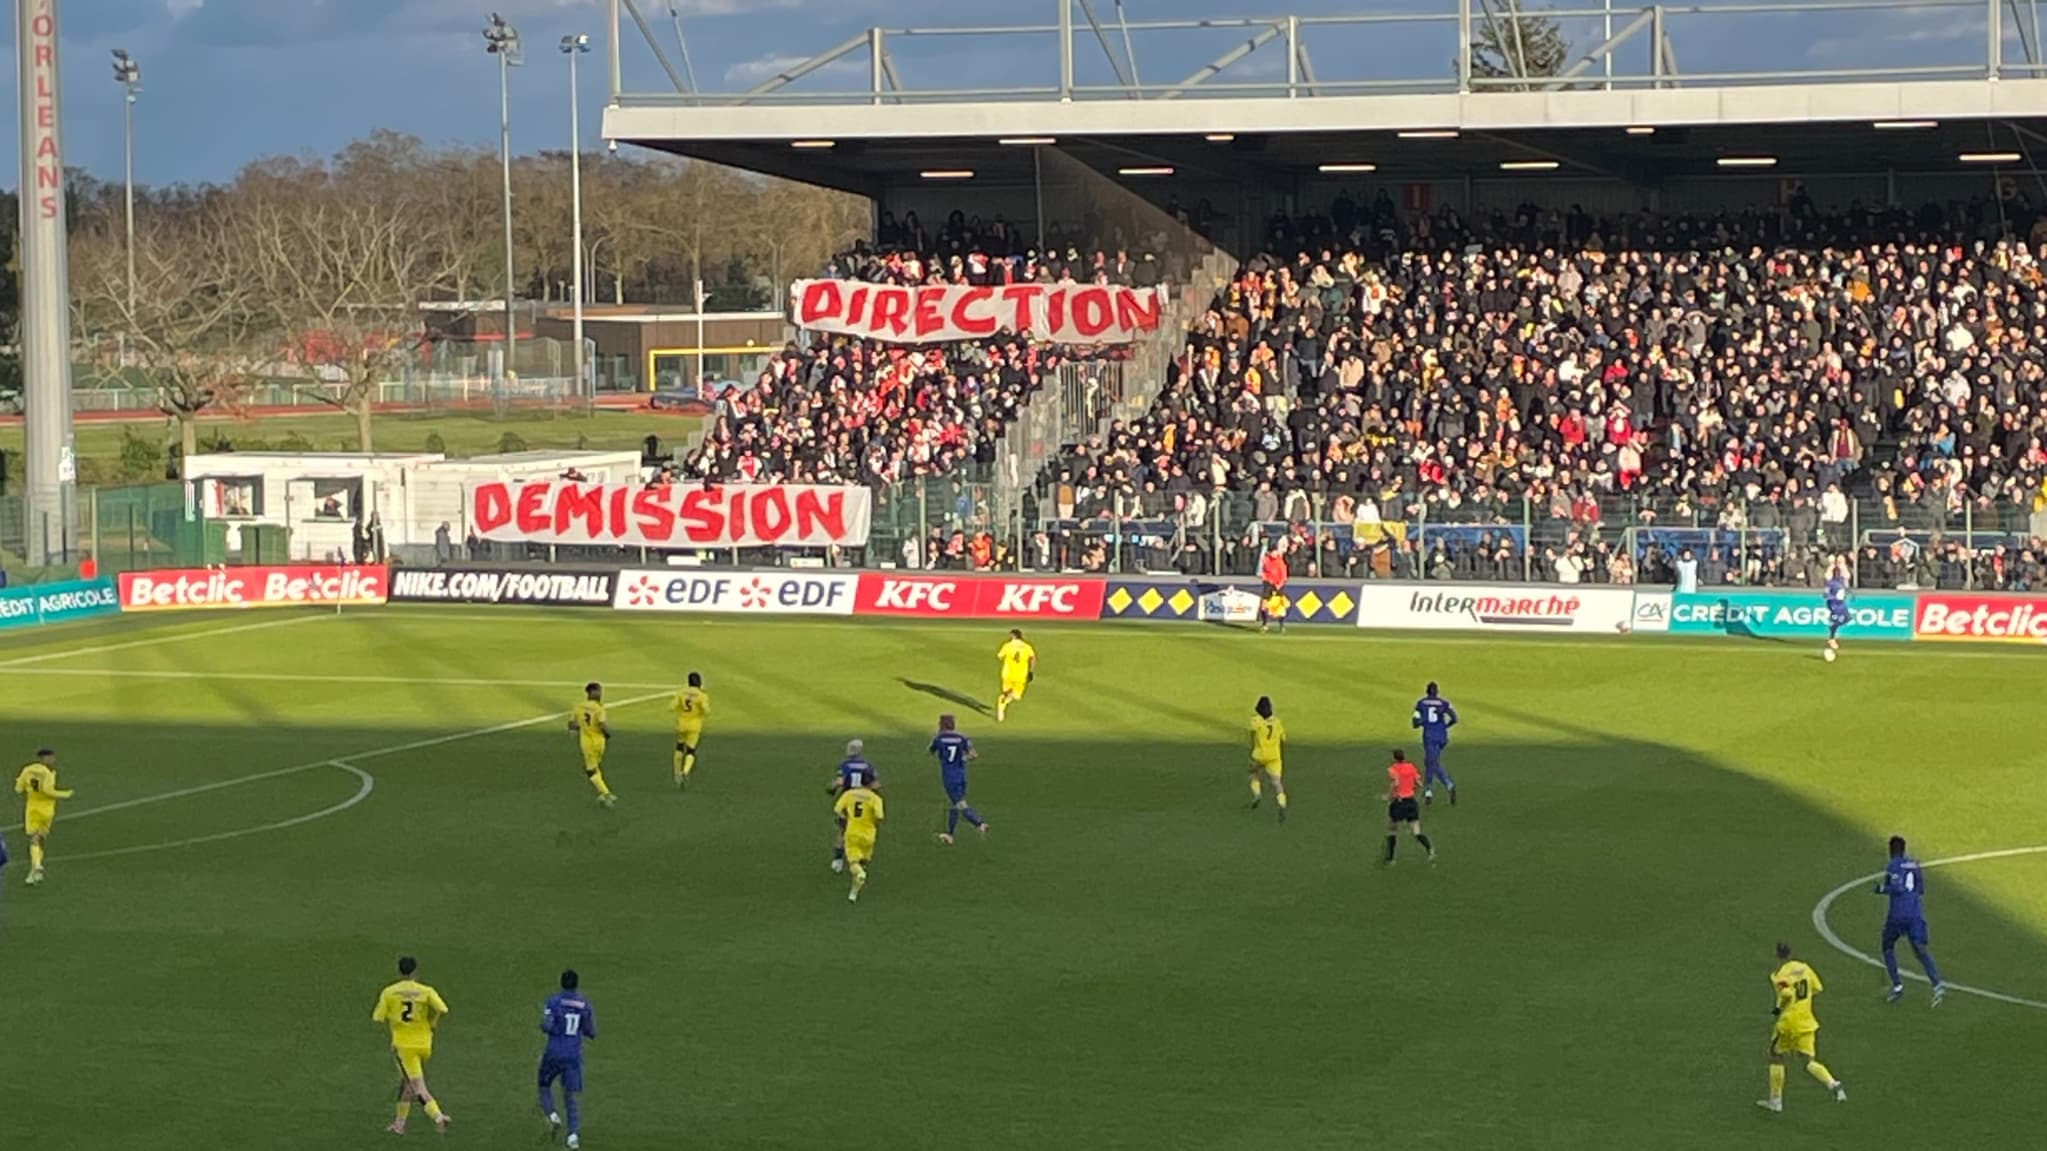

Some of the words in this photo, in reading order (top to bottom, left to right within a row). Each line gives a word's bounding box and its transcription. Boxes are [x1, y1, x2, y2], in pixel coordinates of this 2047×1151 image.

[801, 278, 1162, 337] DIRECTION
[474, 481, 846, 542] DEMISSION
[130, 572, 245, 606] Betclic
[263, 569, 379, 601] Betclic
[393, 570, 610, 602] NIKE.COM/FOOTBALL
[874, 580, 957, 610] KFC
[998, 583, 1080, 612] KFC
[39, 587, 117, 613] AGRICOLE
[1673, 602, 1770, 623] CRÉDIT
[1919, 603, 2047, 637] Betclic
[1428, 706, 1439, 723] 6
[947, 745, 957, 762] 7
[1905, 871, 1915, 892] 4
[401, 1001, 413, 1022] 2
